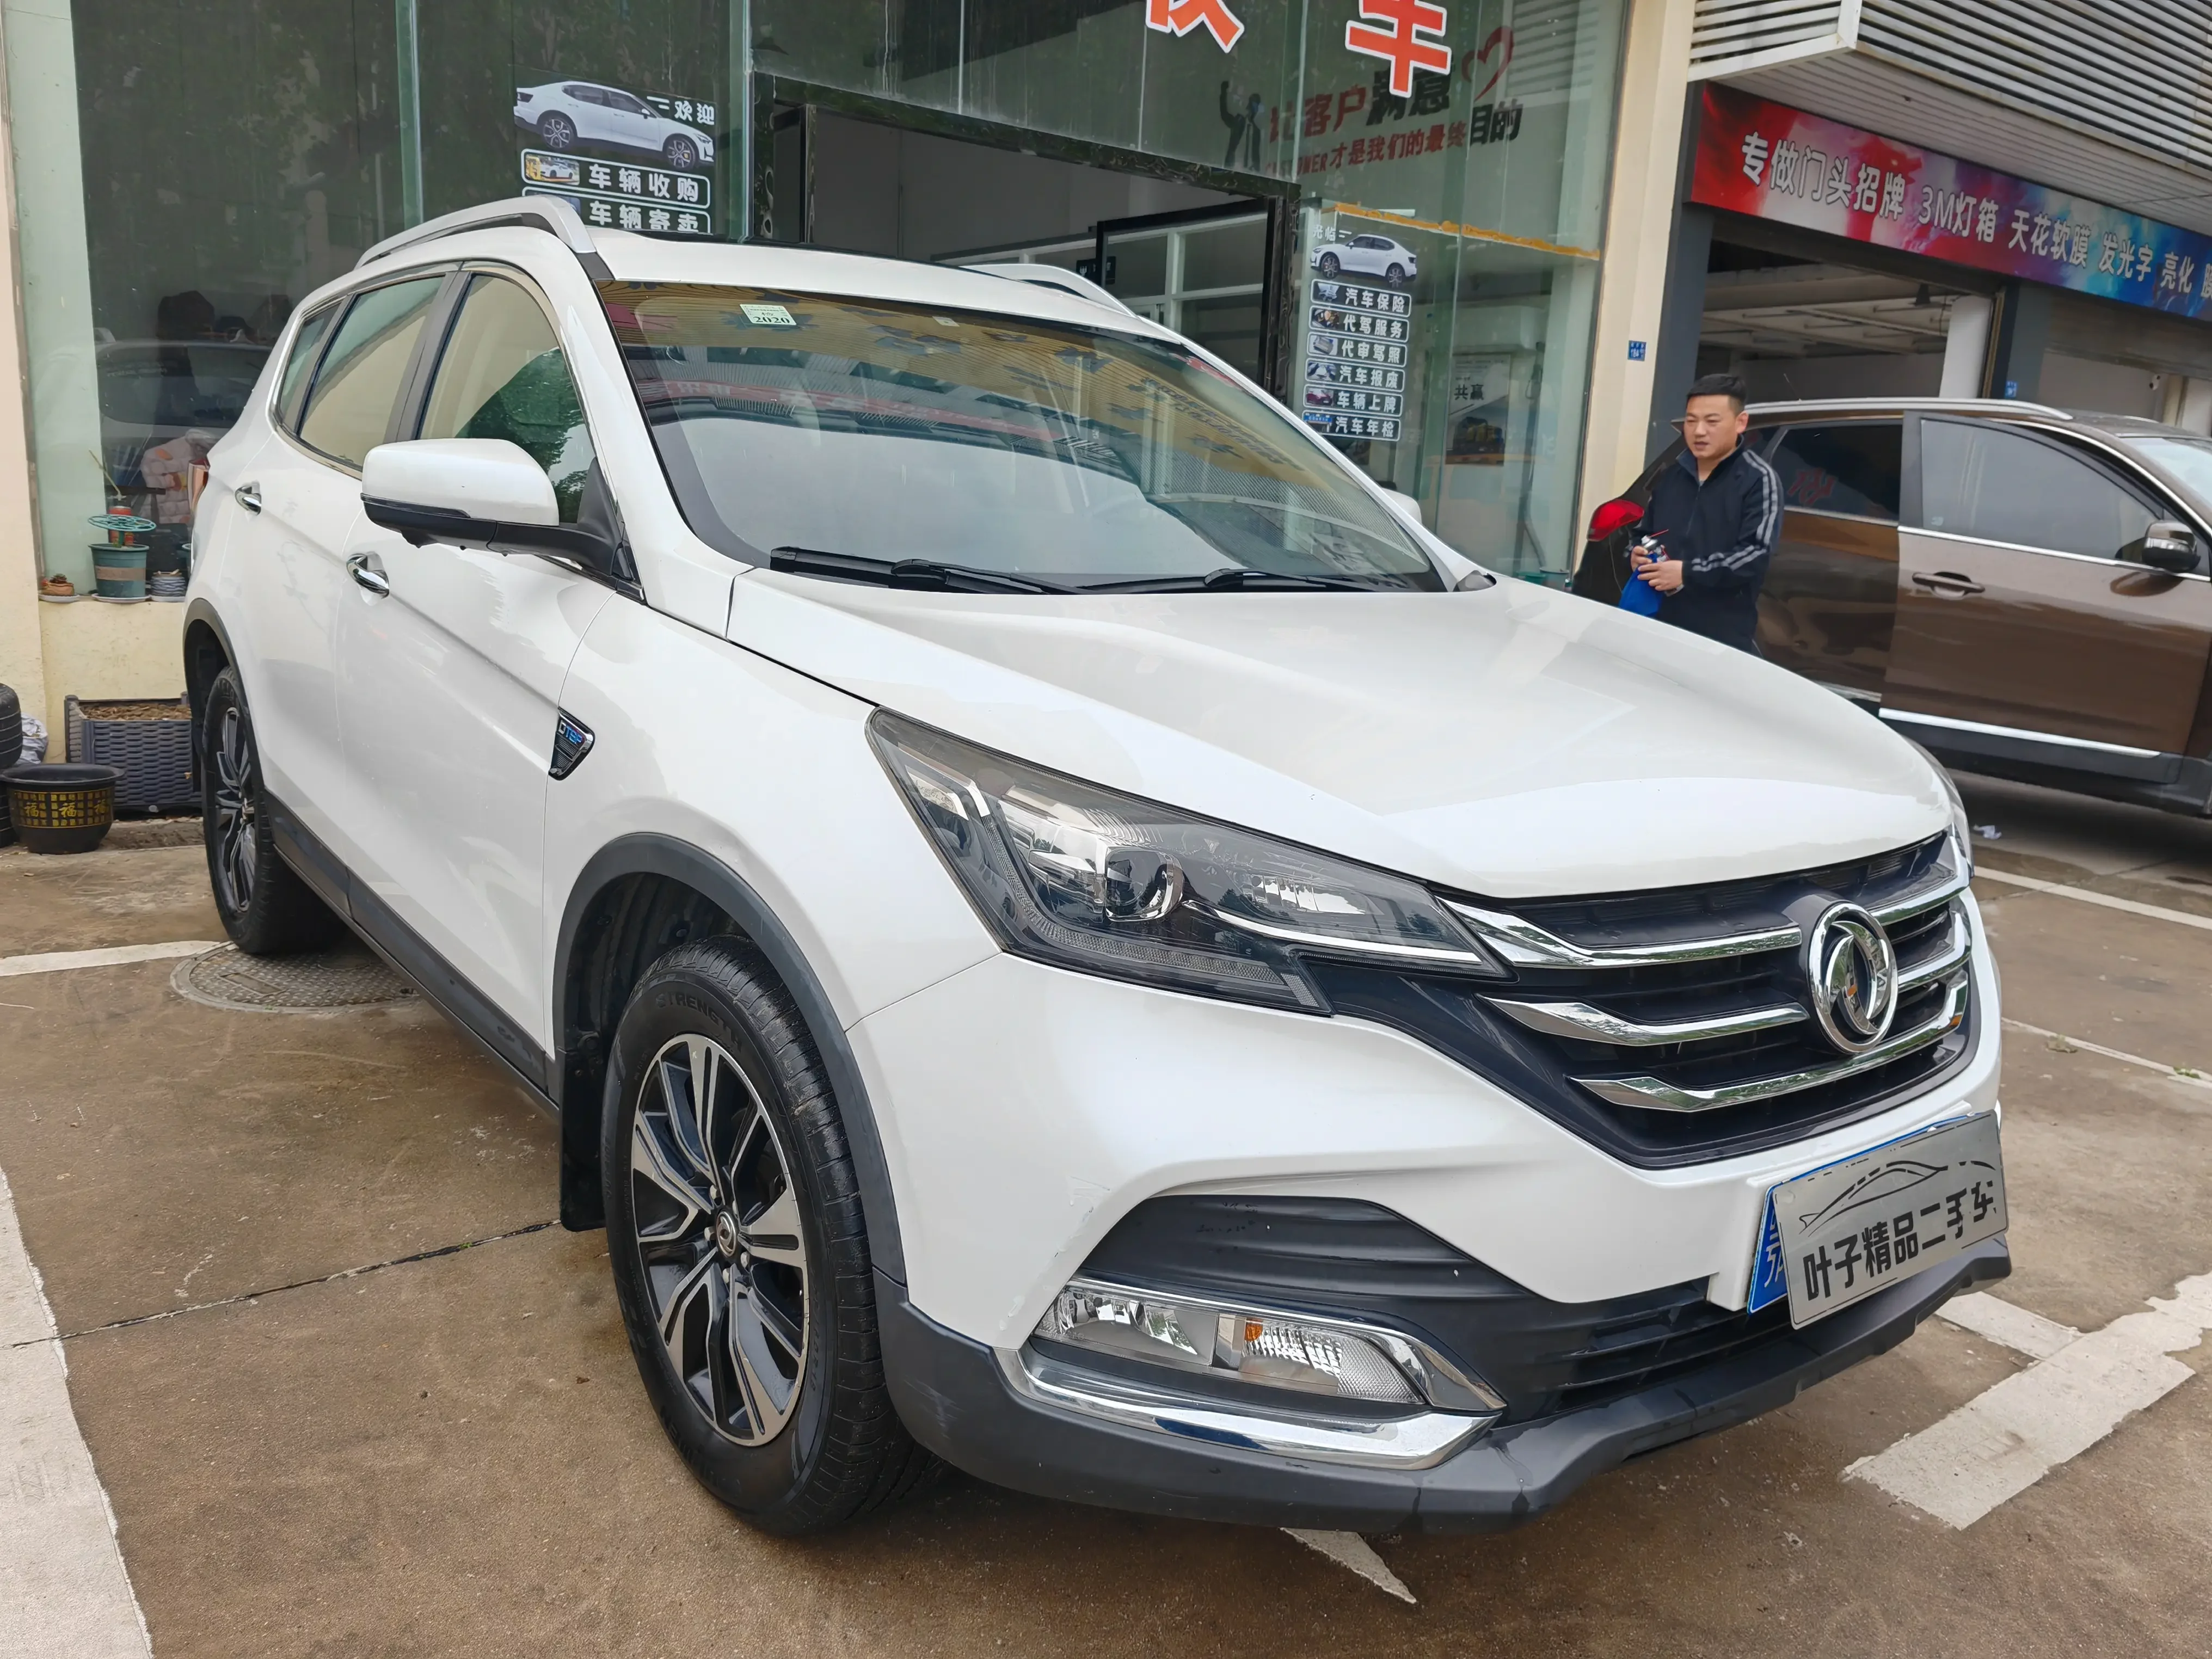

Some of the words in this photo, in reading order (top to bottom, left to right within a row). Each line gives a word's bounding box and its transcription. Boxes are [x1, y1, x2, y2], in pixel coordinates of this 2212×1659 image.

[674, 101, 715, 126] 欢迎
[589, 164, 699, 202] 车辆收购
[589, 201, 700, 234] 车辆寄卖
[1742, 131, 1906, 221] 专做门头招牌
[1919, 185, 1999, 243] 3M灯箱
[2008, 209, 2091, 268] 天花软膜
[2099, 231, 2154, 282] 发光字
[2160, 251, 2195, 294] 亮化
[1313, 224, 1336, 242] 光临
[1344, 287, 1405, 314] 汽车保险
[1343, 314, 1403, 339] 代驾服务
[1341, 340, 1401, 364] 代审驾照
[1339, 365, 1399, 389] 汽车报废
[1337, 391, 1397, 414] 车辆上牌
[1335, 416, 1394, 438] 汽车年检
[25, 802, 39, 817] 福
[60, 802, 77, 818] 福
[1803, 1180, 1997, 1301] 叶子精品二手车
